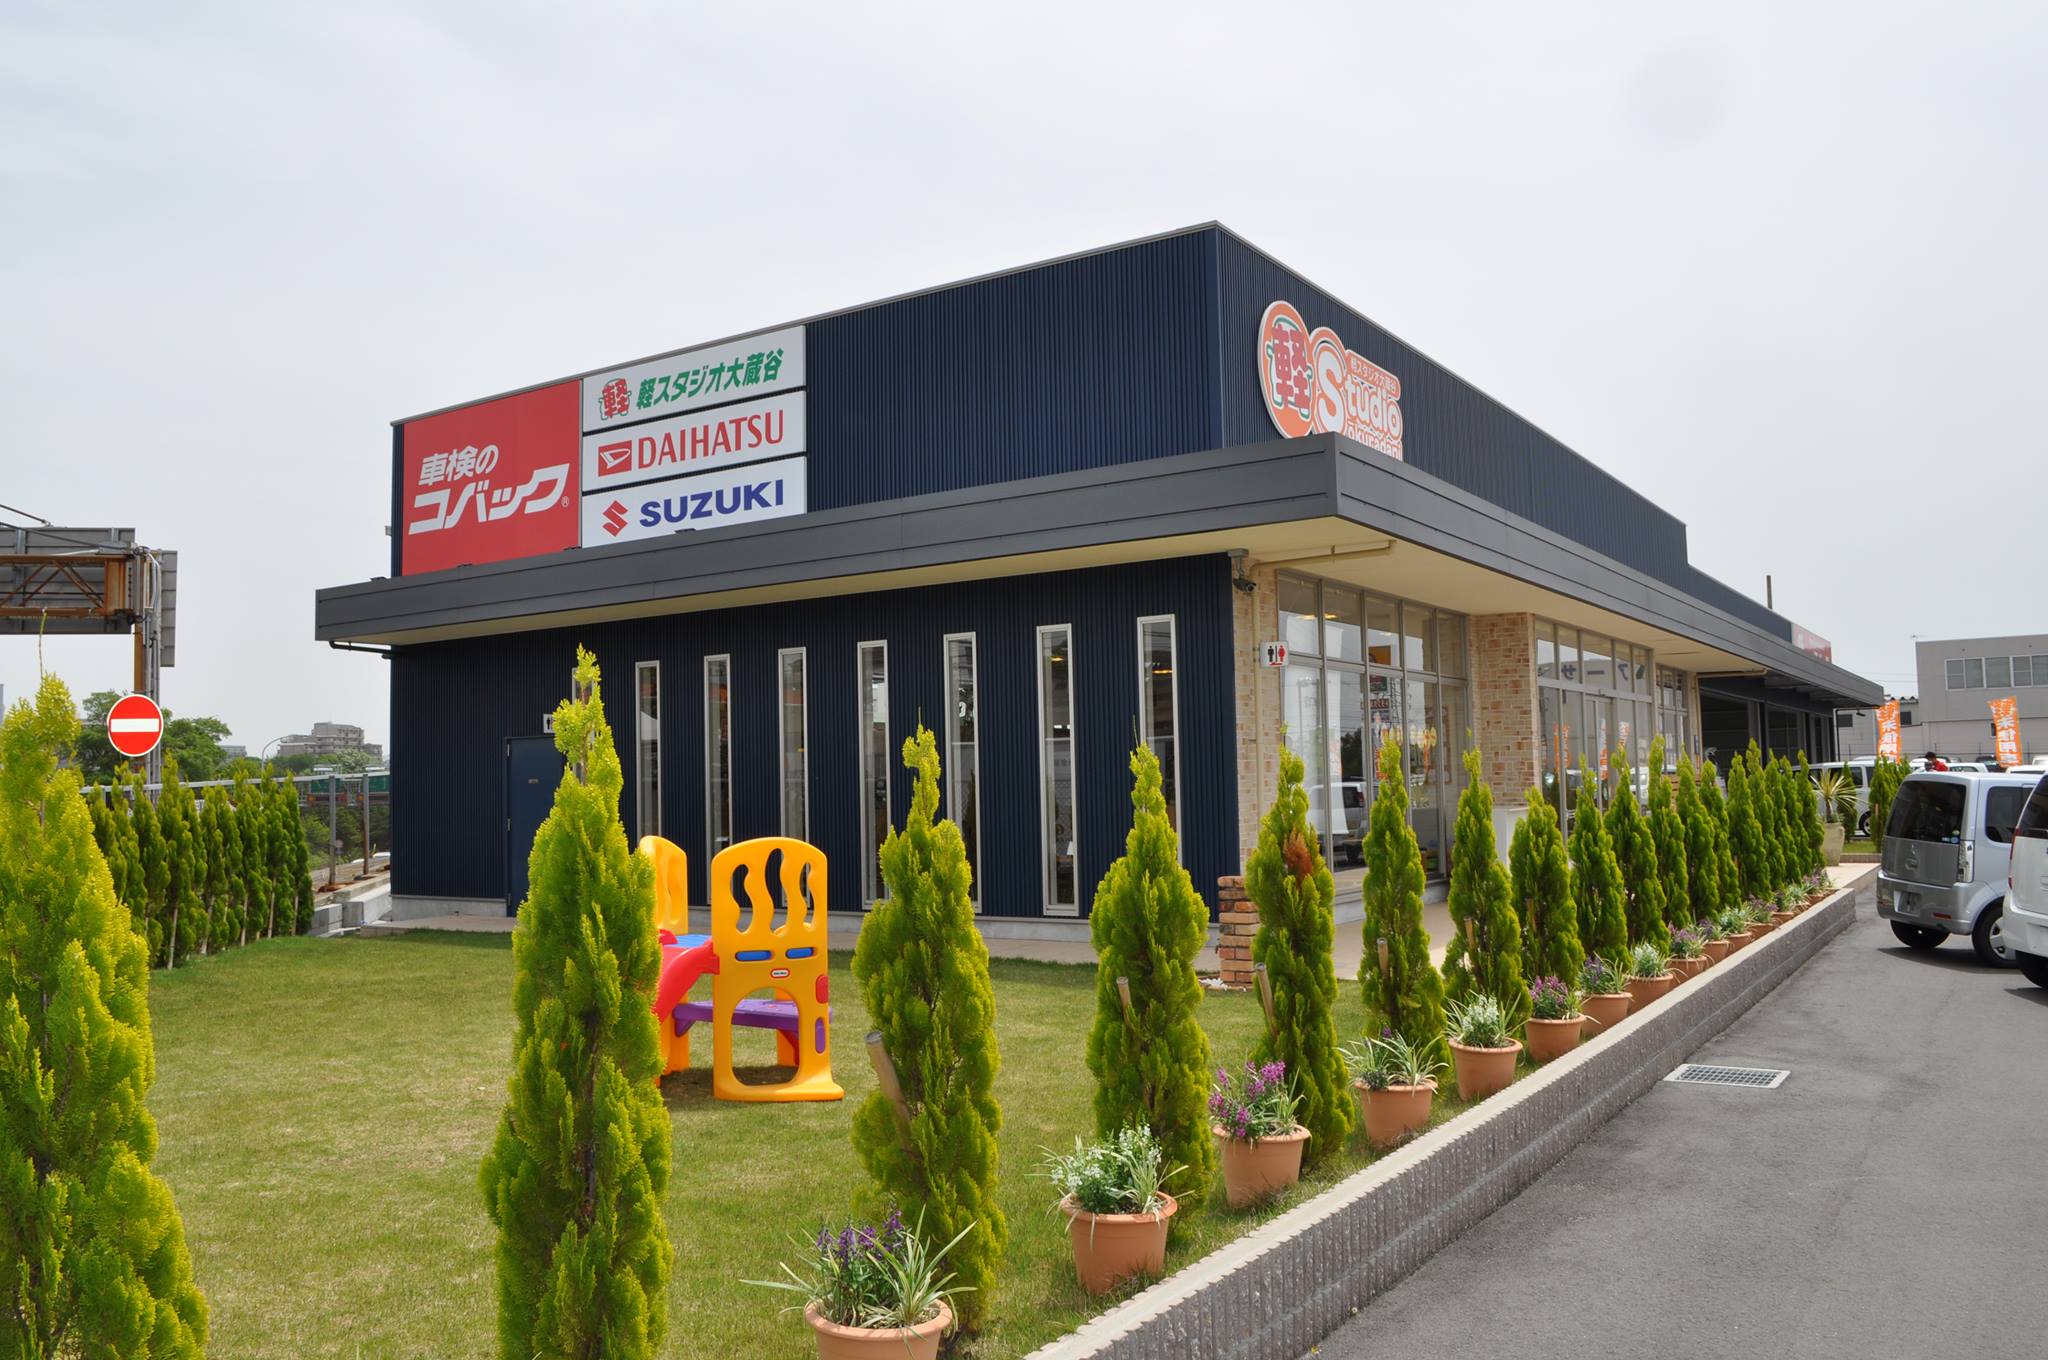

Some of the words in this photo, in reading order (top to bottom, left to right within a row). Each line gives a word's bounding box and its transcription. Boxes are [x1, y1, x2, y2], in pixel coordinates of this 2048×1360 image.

[636, 348, 784, 410] 軽スタジオ大蔵谷
[1272, 323, 1310, 409] 軽
[1318, 351, 1400, 437] Studio
[418, 444, 499, 486] 車検の
[638, 410, 784, 470] DAIHATSU
[408, 463, 571, 535] コバック
[639, 479, 784, 527] SUZUKI
